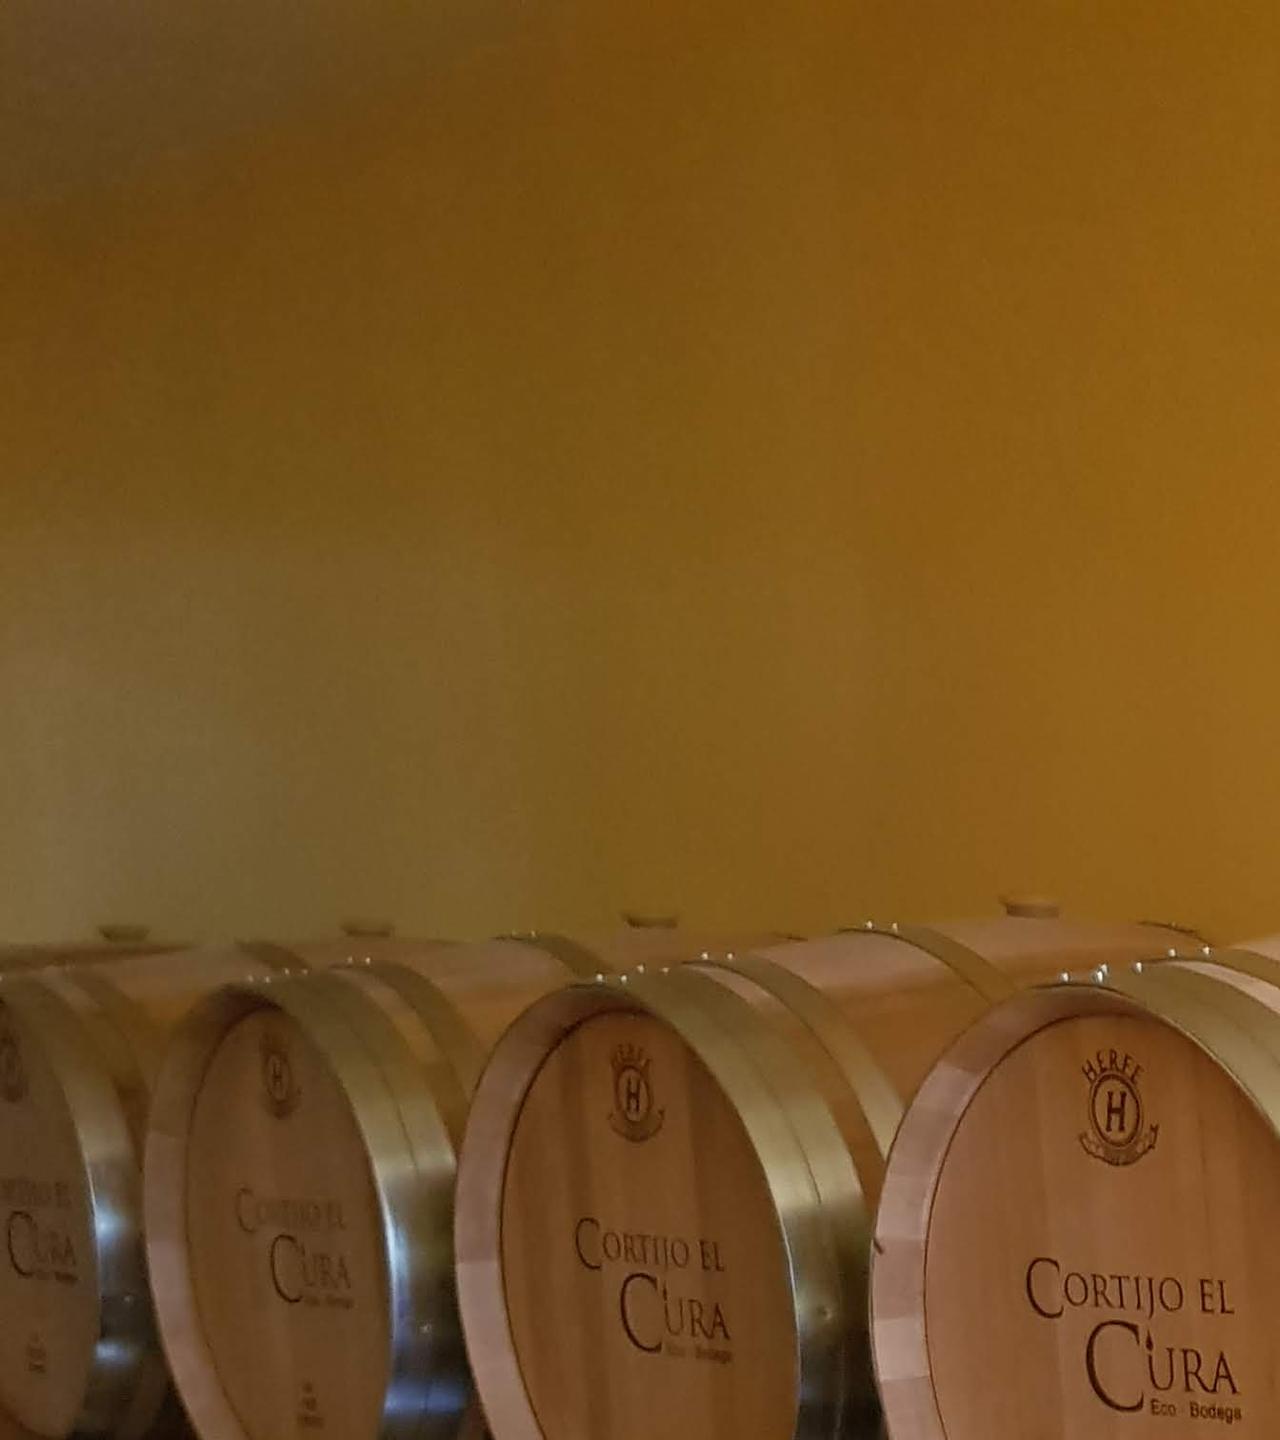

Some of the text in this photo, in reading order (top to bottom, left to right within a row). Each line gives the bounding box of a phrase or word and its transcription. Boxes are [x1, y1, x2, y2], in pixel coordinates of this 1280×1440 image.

[1105, 1090, 1127, 1132] H
[620, 1272, 731, 1353] CURA
[1026, 1257, 1235, 1320] CORTIJO EL
[1085, 1319, 1241, 1413] CURA
